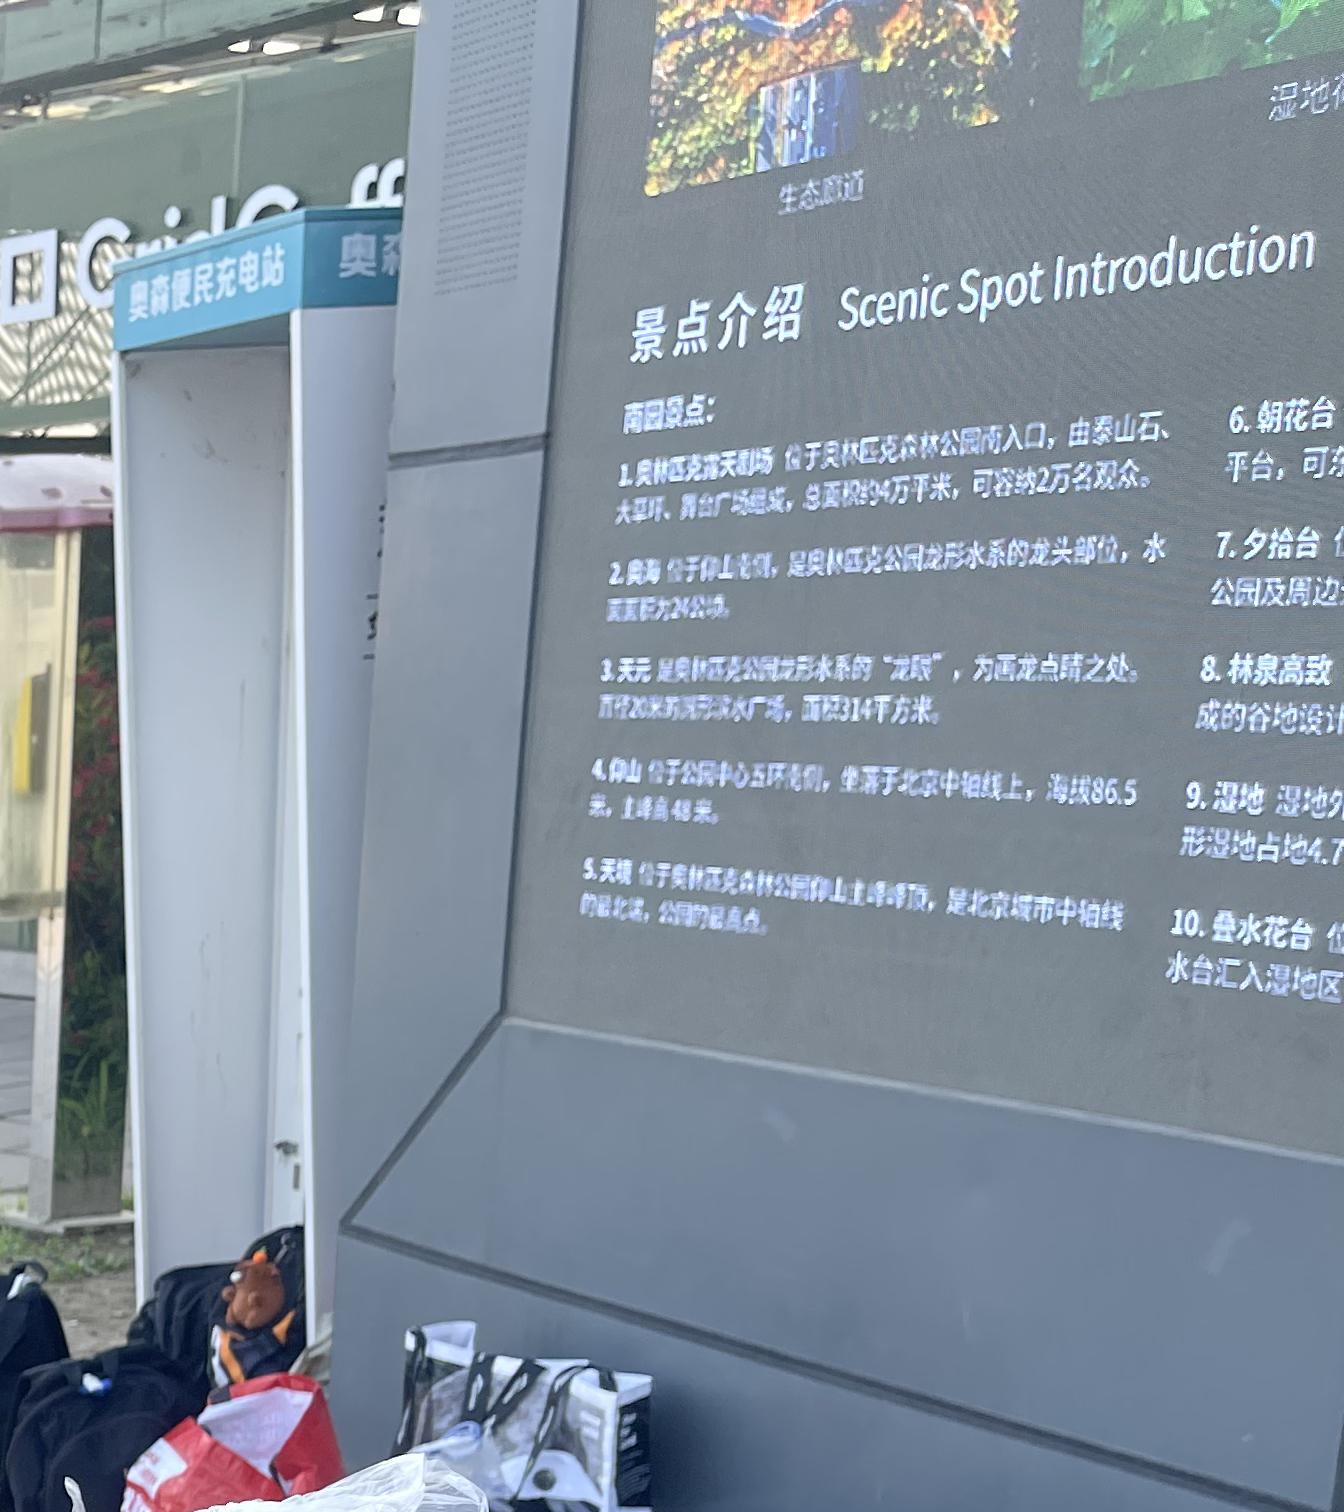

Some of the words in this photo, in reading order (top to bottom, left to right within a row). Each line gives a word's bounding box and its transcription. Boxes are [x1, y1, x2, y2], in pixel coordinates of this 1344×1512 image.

[128, 242, 286, 323] 奥森便民充电站
[838, 274, 949, 331] Scenic
[958, 262, 1046, 322] Spot
[629, 283, 806, 365] 景点介绍
[1210, 576, 1344, 607] 公园及周边
